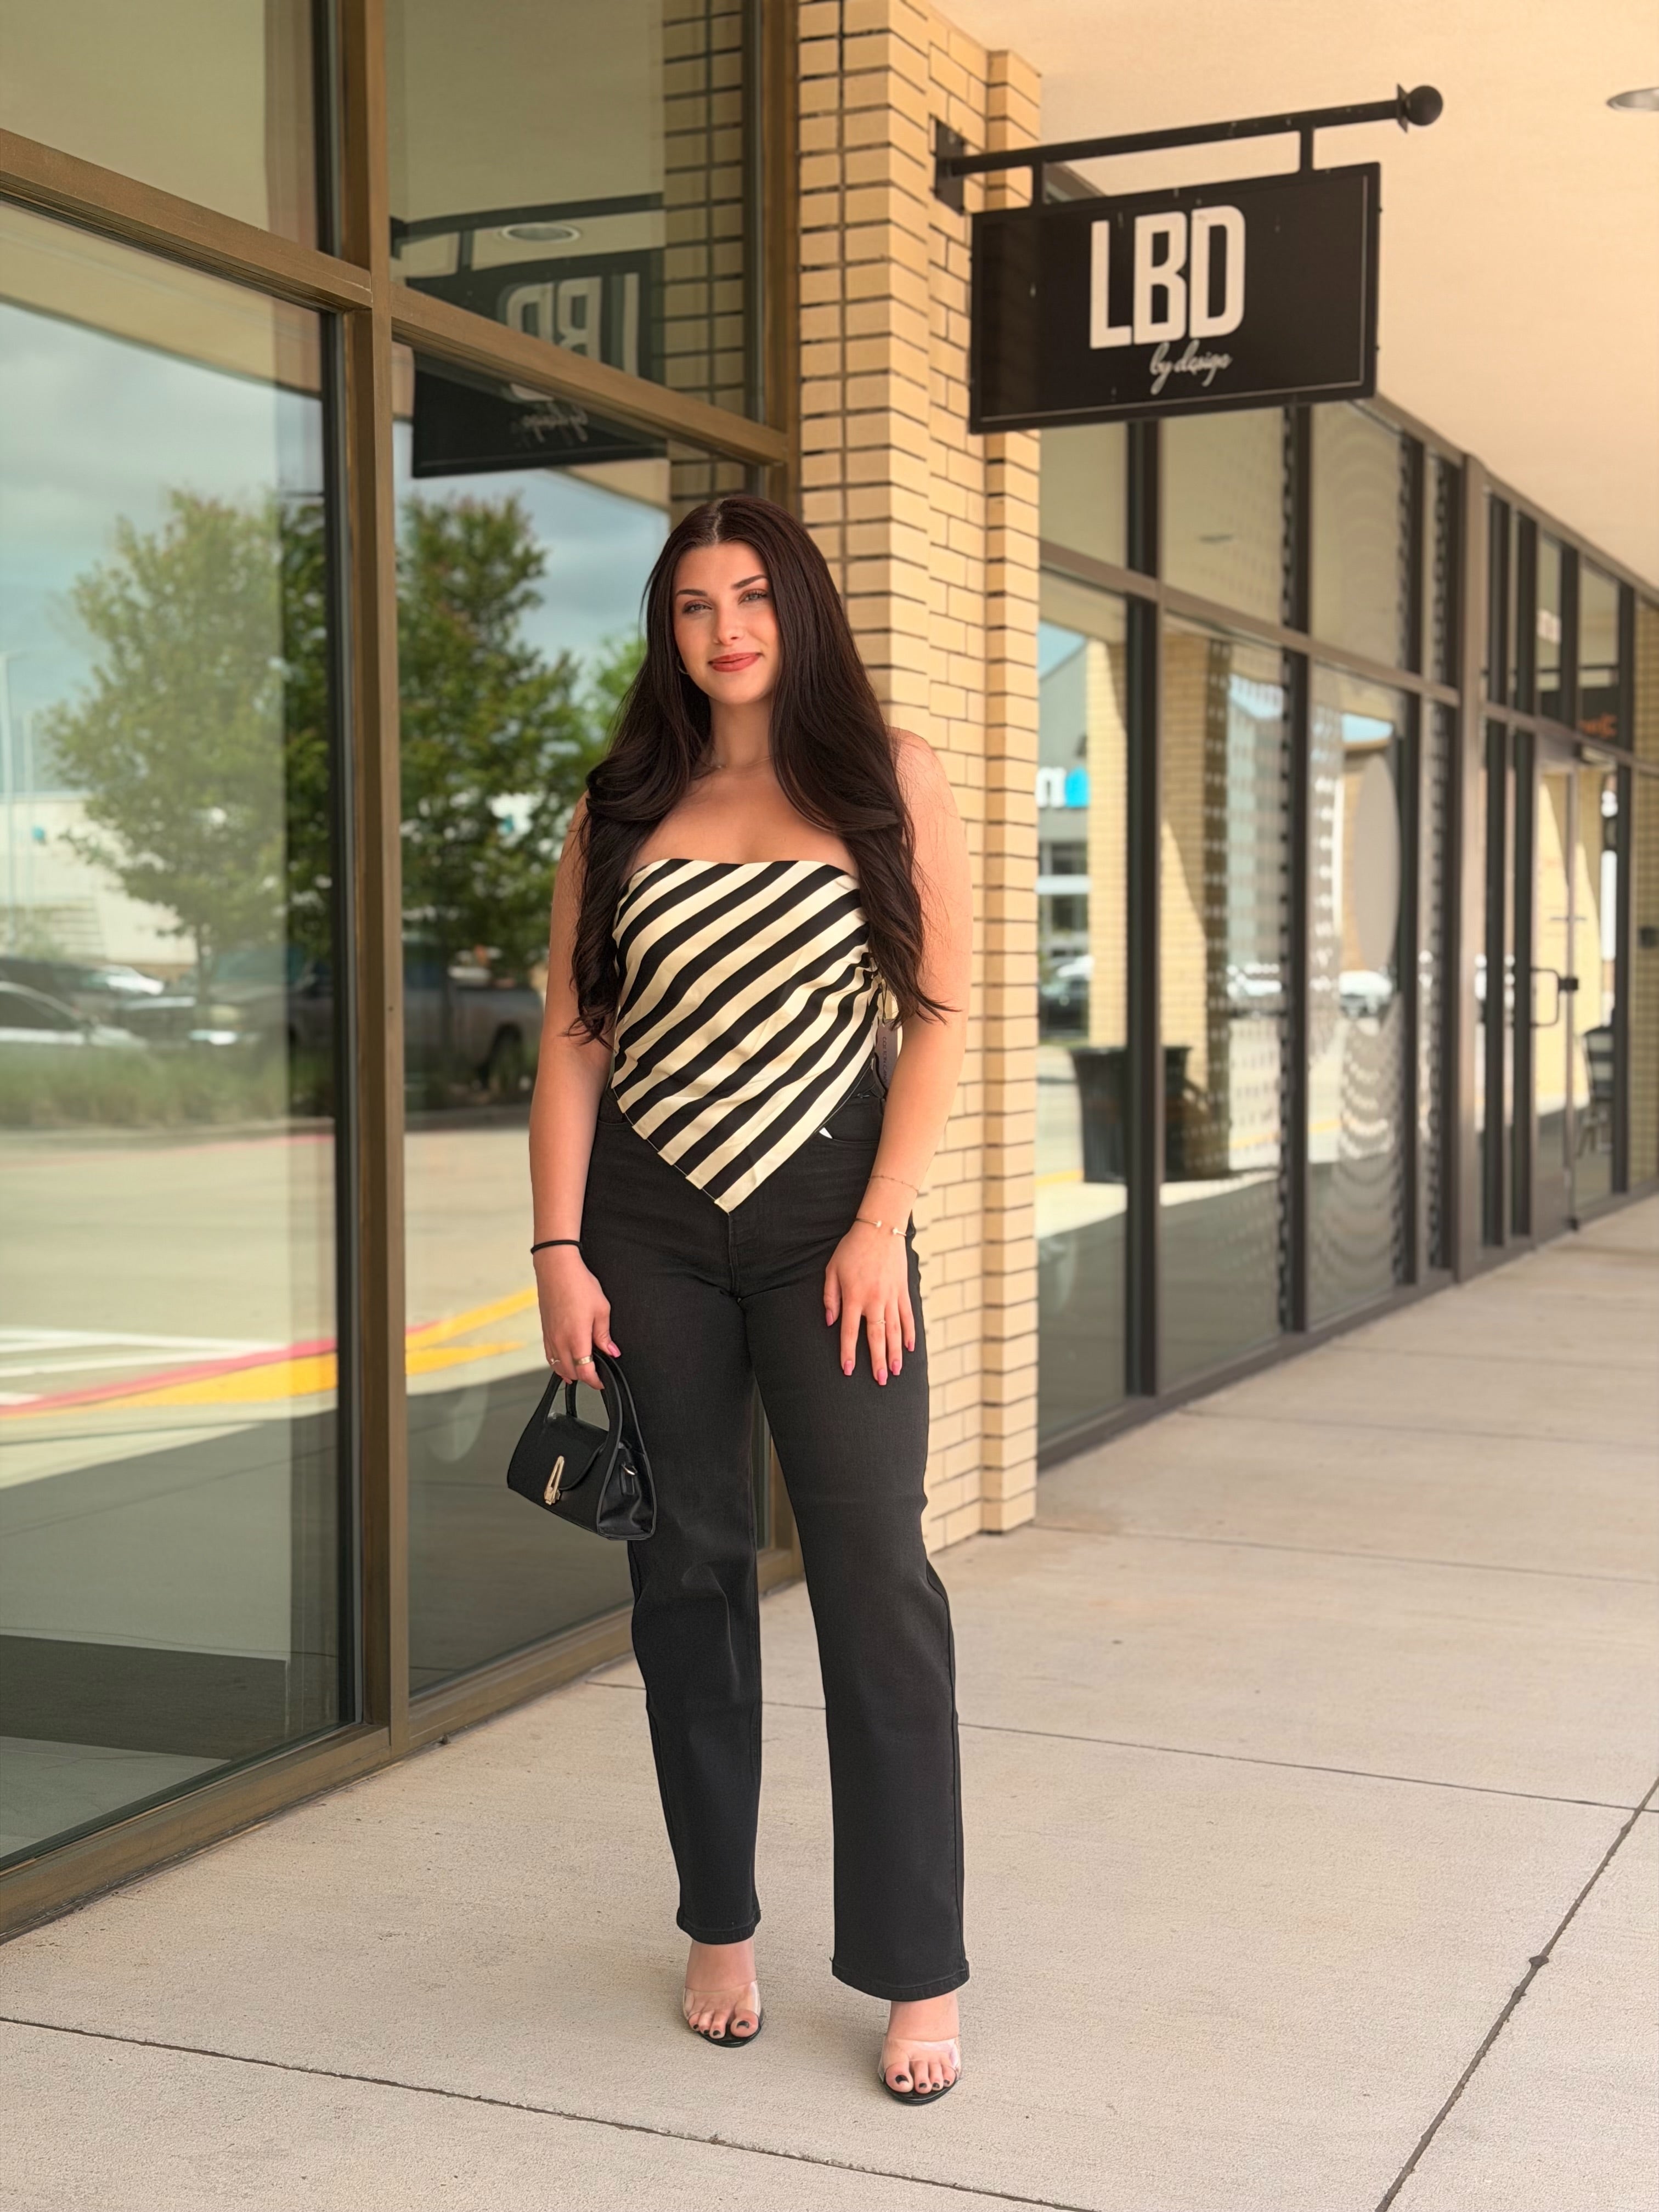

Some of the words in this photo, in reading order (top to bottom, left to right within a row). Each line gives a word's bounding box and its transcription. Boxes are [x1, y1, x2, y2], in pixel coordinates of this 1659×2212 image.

[1090, 205, 1246, 349] LBD
[1149, 341, 1173, 396] by
[1173, 338, 1233, 387] design
